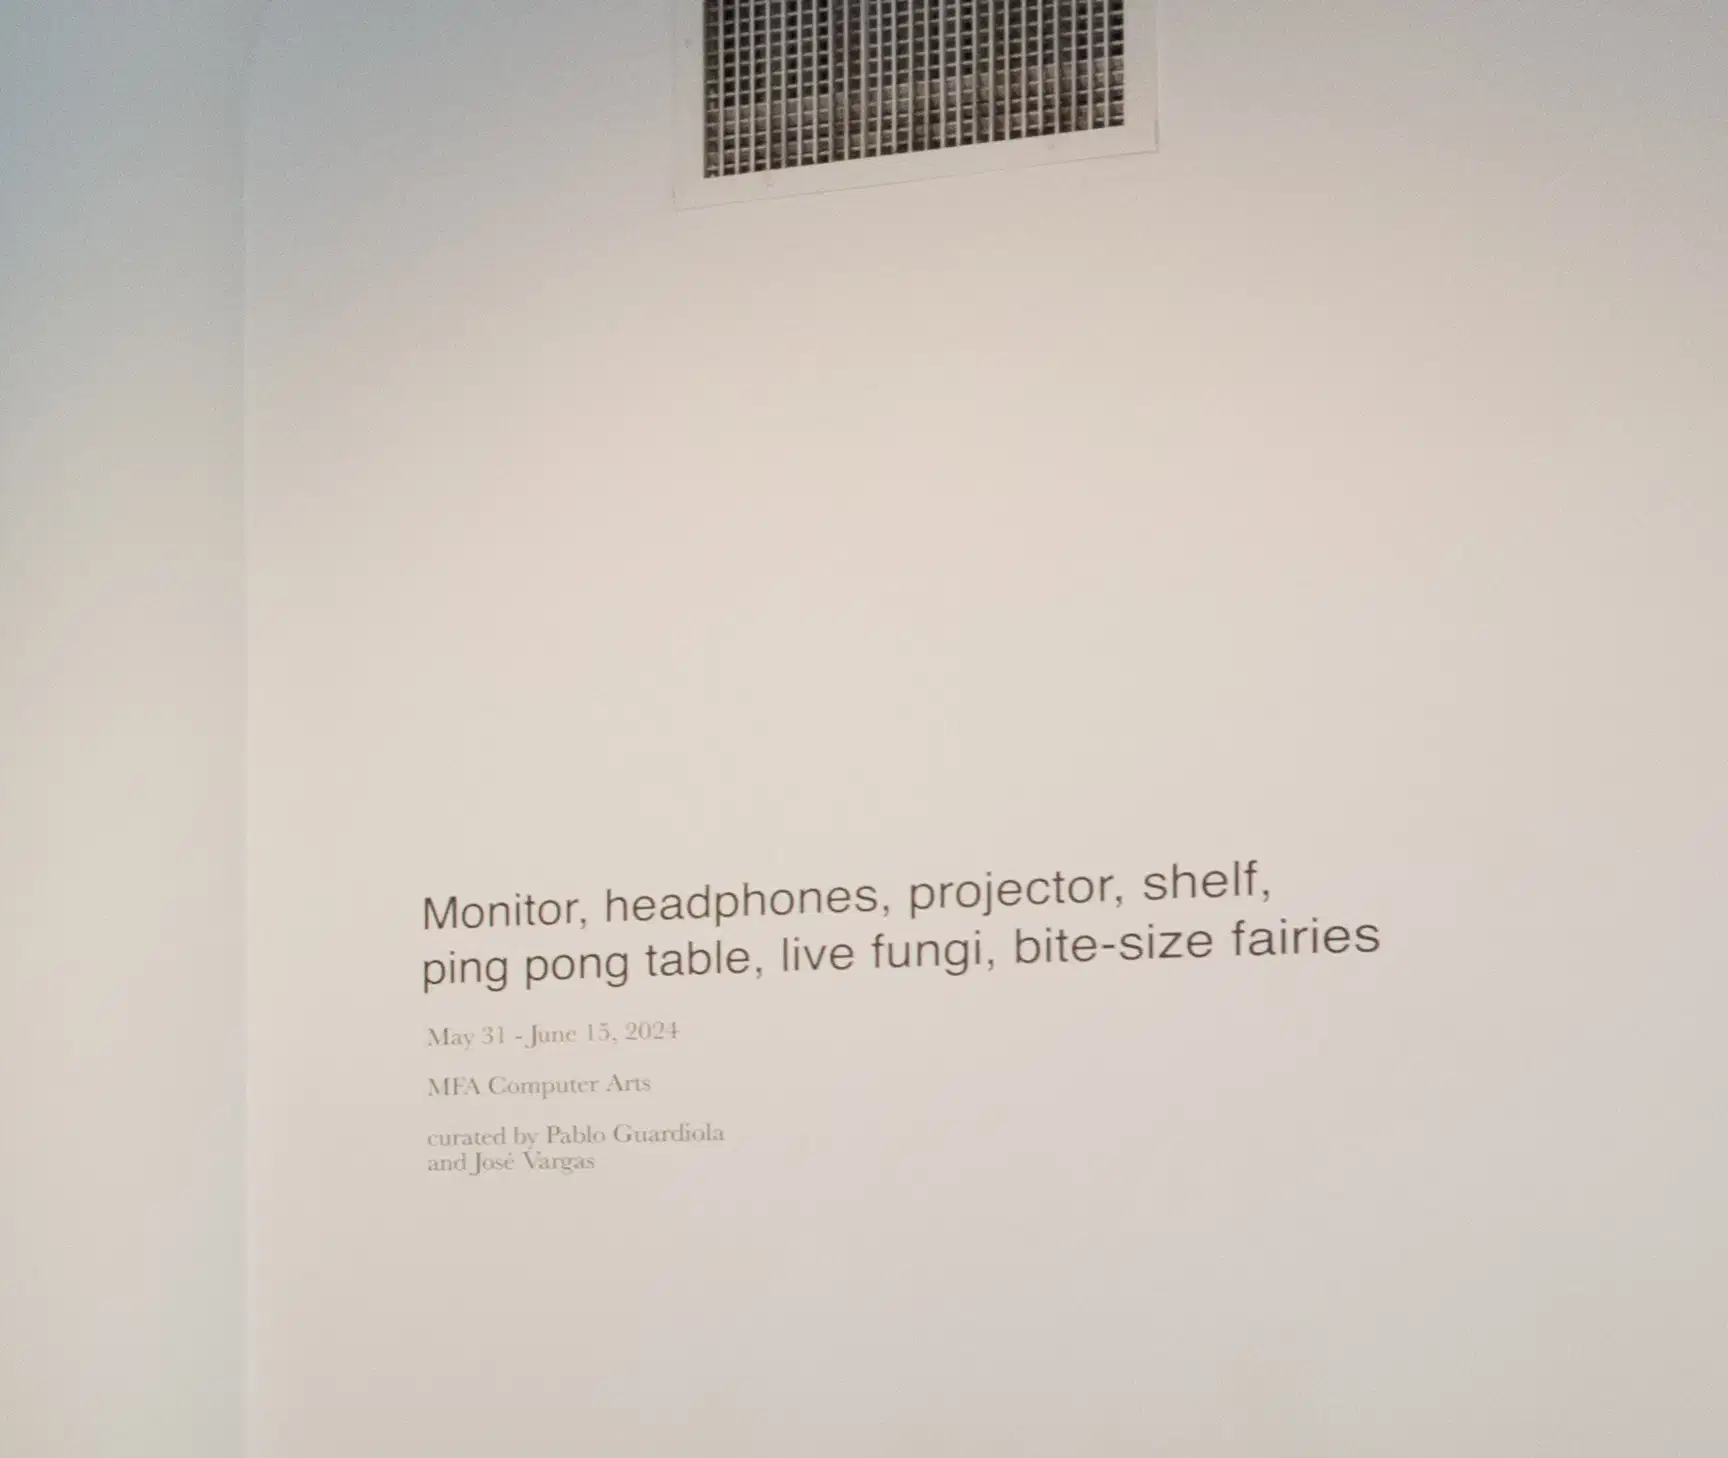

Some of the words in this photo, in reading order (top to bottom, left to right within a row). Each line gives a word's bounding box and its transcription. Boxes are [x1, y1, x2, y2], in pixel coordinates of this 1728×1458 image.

[423, 892, 587, 930] Monitor,
[606, 882, 891, 928] headphones,
[909, 870, 1123, 920] projector,
[1143, 859, 1271, 903] shelf,
[422, 950, 508, 994] ping
[525, 952, 629, 991] pong
[644, 939, 763, 979] table,
[782, 936, 855, 973] live
[871, 929, 995, 977] fungi,
[1015, 923, 1214, 965] bite-size
[1231, 916, 1382, 957] fairies
[427, 1027, 473, 1050] May
[481, 1026, 505, 1045] 31
[524, 1024, 577, 1049] June
[586, 1022, 618, 1045] 15,
[624, 1021, 680, 1042] 2024
[427, 1076, 481, 1097] MFA
[488, 1075, 600, 1100] Computer
[605, 1073, 652, 1093] Arts
[427, 1126, 506, 1147] curated
[513, 1125, 539, 1149] by
[546, 1124, 606, 1145] Pablo
[612, 1121, 725, 1144] Guardiola
[427, 1152, 467, 1172] and
[469, 1152, 515, 1176] José
[521, 1150, 597, 1175] Vargas
